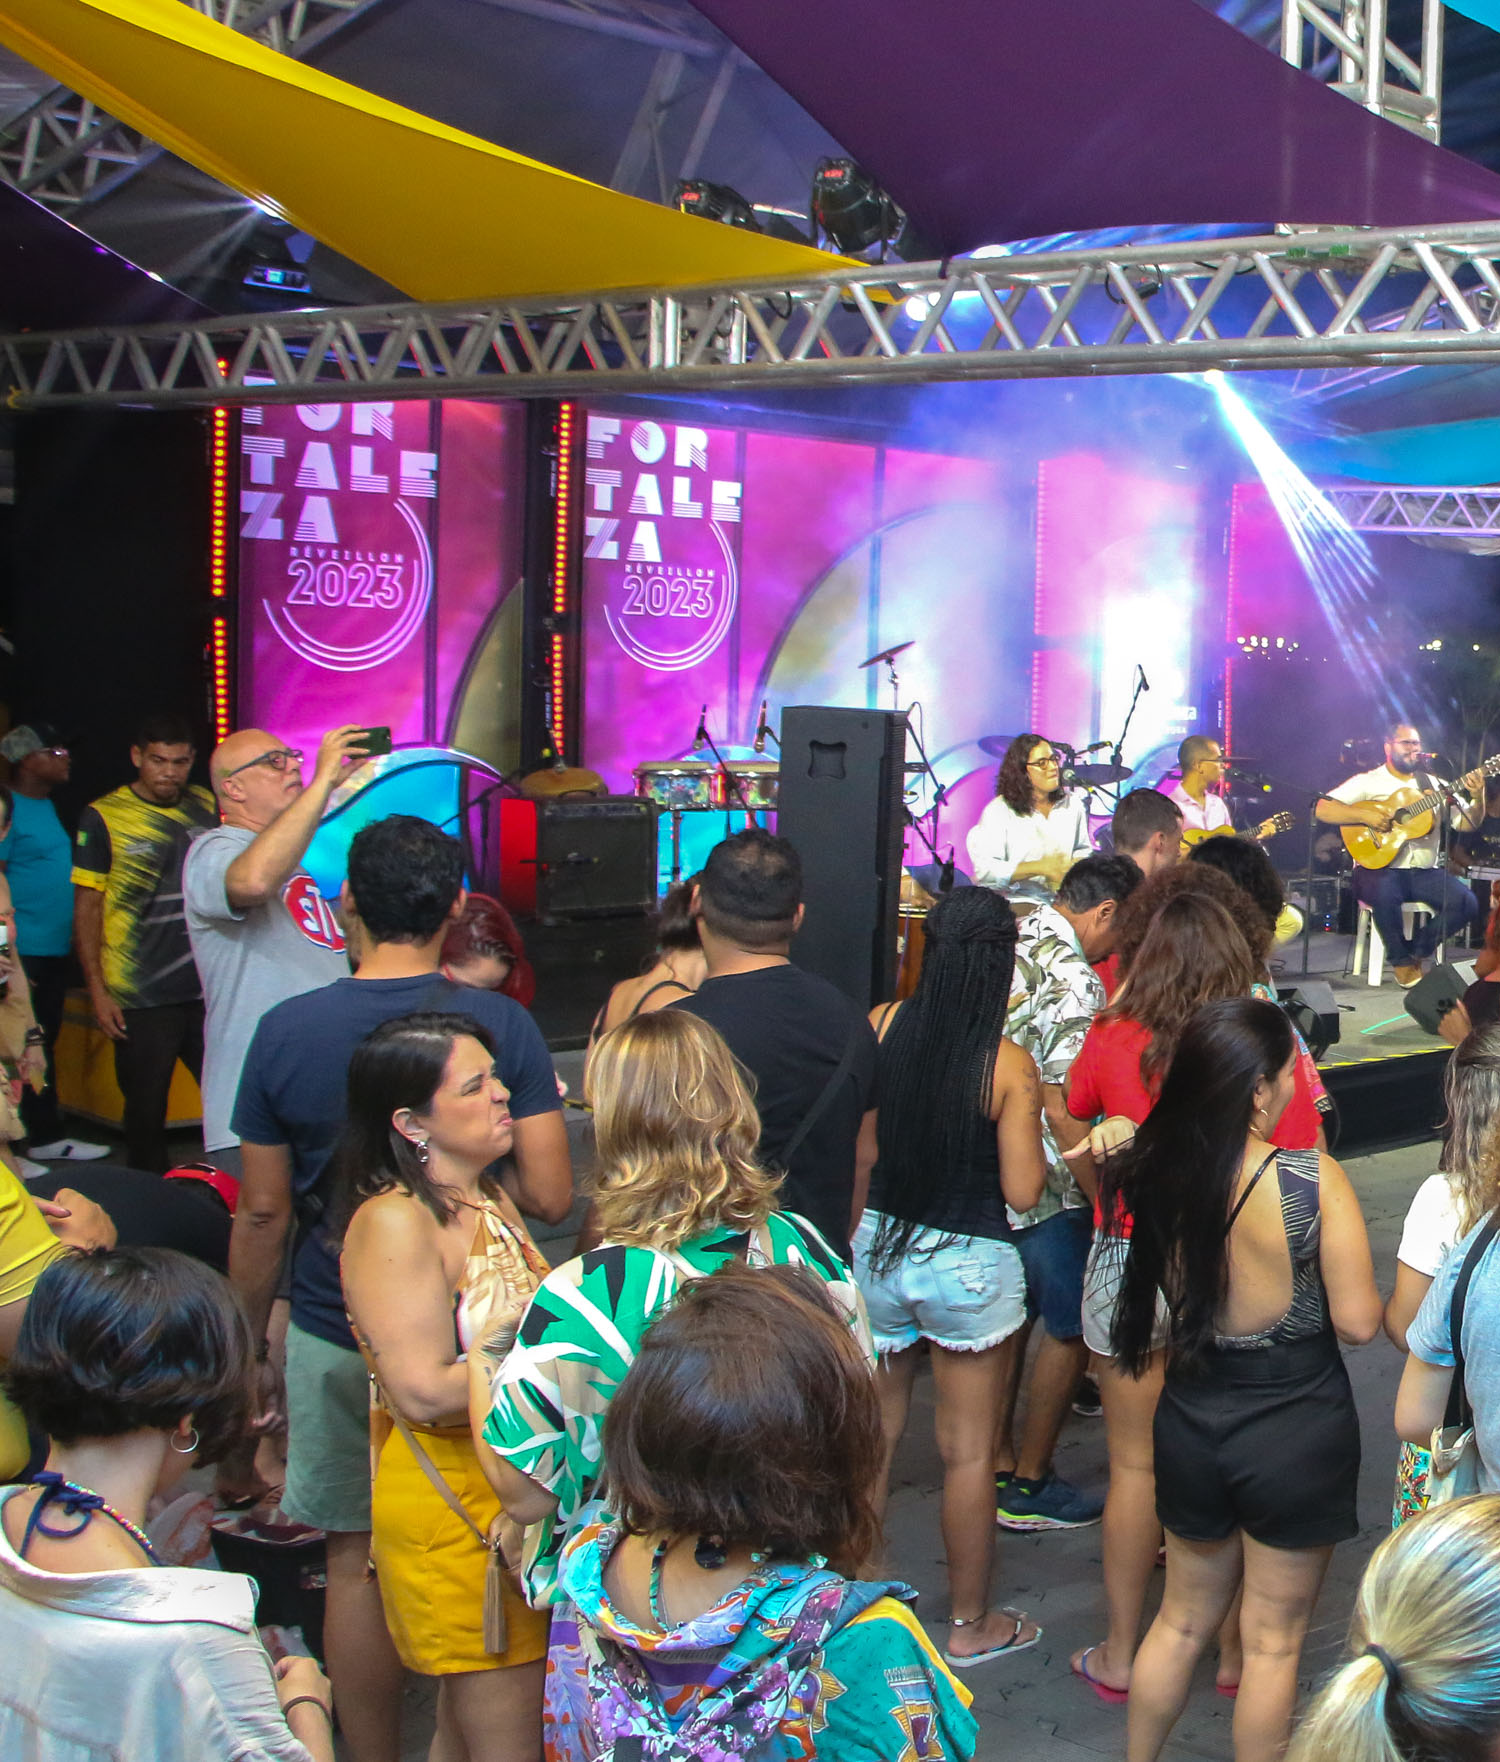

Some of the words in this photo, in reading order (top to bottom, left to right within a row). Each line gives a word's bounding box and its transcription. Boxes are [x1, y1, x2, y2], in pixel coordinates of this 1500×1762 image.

[241, 435, 438, 498] TALE
[587, 416, 708, 472] FOR
[240, 491, 339, 544] ZA
[585, 467, 742, 522] TALE
[584, 517, 662, 562] ZA
[286, 559, 404, 609] 2023
[622, 575, 715, 618] 2023
